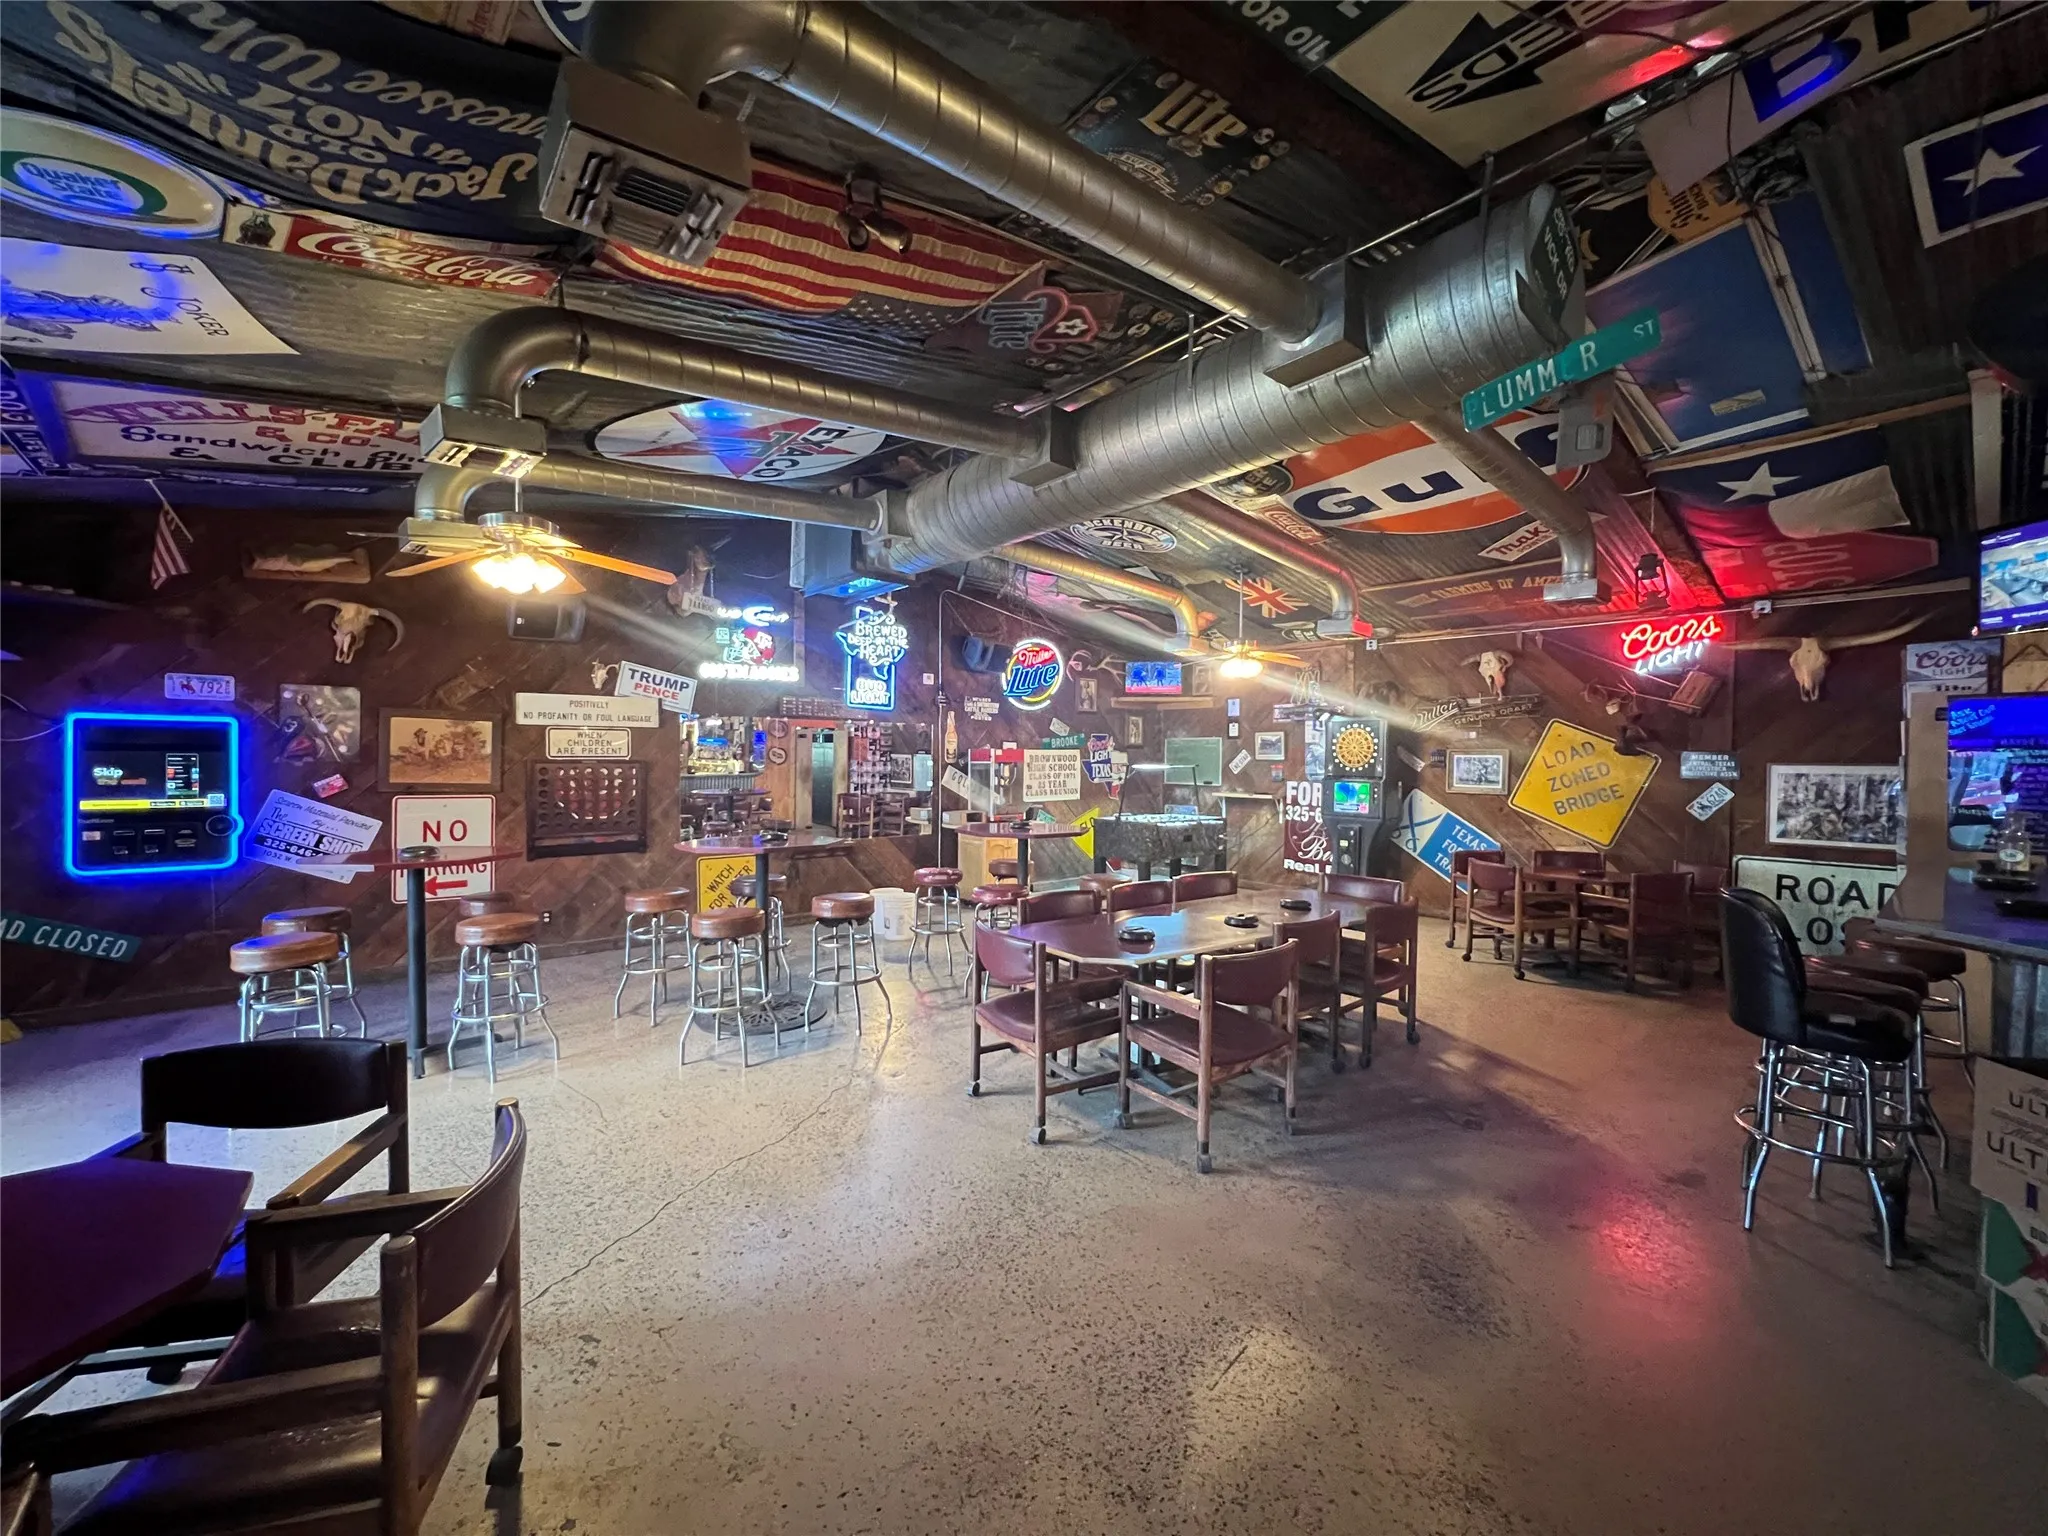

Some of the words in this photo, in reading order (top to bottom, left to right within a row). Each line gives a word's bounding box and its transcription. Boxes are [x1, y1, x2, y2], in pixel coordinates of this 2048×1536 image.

[1285, 26, 1331, 62] OIL
[1138, 79, 1248, 148] Lite
[266, 123, 388, 164] OLD
[20, 162, 121, 189] Quaker
[374, 152, 538, 204] Jack
[1668, 189, 1695, 229] Shin
[297, 232, 553, 286] Coca-Cola
[141, 286, 230, 338] JOKER
[1633, 318, 1655, 338] ST
[120, 425, 341, 458] Sandwich
[307, 431, 382, 448] CO.
[752, 426, 851, 478] EXACO
[268, 454, 413, 471] CLUB
[1497, 578, 1514, 590] OF
[855, 620, 908, 639] BREWED
[1621, 614, 1722, 660] Coors
[859, 643, 901, 660] HEART
[1019, 649, 1055, 667] Miller
[1633, 639, 1712, 676] LIGHT
[1916, 650, 1989, 669] Coors
[628, 668, 690, 692] TRUMP
[1003, 663, 1059, 696] Lite
[1931, 666, 1975, 677] LIGHT
[199, 680, 224, 695] 792
[634, 682, 680, 701] PENCE
[569, 699, 610, 709] POSITIVELY
[1413, 701, 1459, 726] Miller
[523, 711, 534, 720] NO
[537, 711, 579, 721] PROFANITY
[582, 713, 593, 721] OR
[596, 713, 614, 722] FOUL
[617, 714, 653, 723] LANGUAGE
[1454, 710, 1497, 725] GENUINE
[1499, 703, 1533, 716] DRAFT
[567, 738, 613, 747] CHILDREN
[576, 731, 603, 740] WHEN
[1051, 735, 1079, 749] BROOKE
[555, 747, 576, 755] ARE
[580, 747, 623, 755] PRESENT
[1029, 754, 1078, 763] BROWNWOOD
[1090, 750, 1112, 763] LIGH
[1542, 741, 1597, 769] LOAD
[92, 766, 124, 778] Skip
[1029, 772, 1052, 781] CLASS
[1048, 762, 1077, 772] SCHOOL
[1546, 762, 1612, 793] ZONED
[1025, 790, 1048, 798] CLASS
[1049, 788, 1079, 797] REUNION
[1553, 784, 1625, 816] BRIDGE
[270, 806, 289, 821] The
[275, 797, 303, 811] Screen
[305, 805, 340, 820] Material
[339, 816, 374, 831] Provided
[1285, 805, 1323, 824] 325-6
[258, 820, 320, 847] SCREEN
[421, 819, 468, 843] NO
[1452, 824, 1488, 851] TEXAS
[1283, 859, 1320, 874] Real
[706, 864, 736, 893] WATCH
[708, 892, 728, 910] FOR
[33, 925, 129, 958] CLOSED
